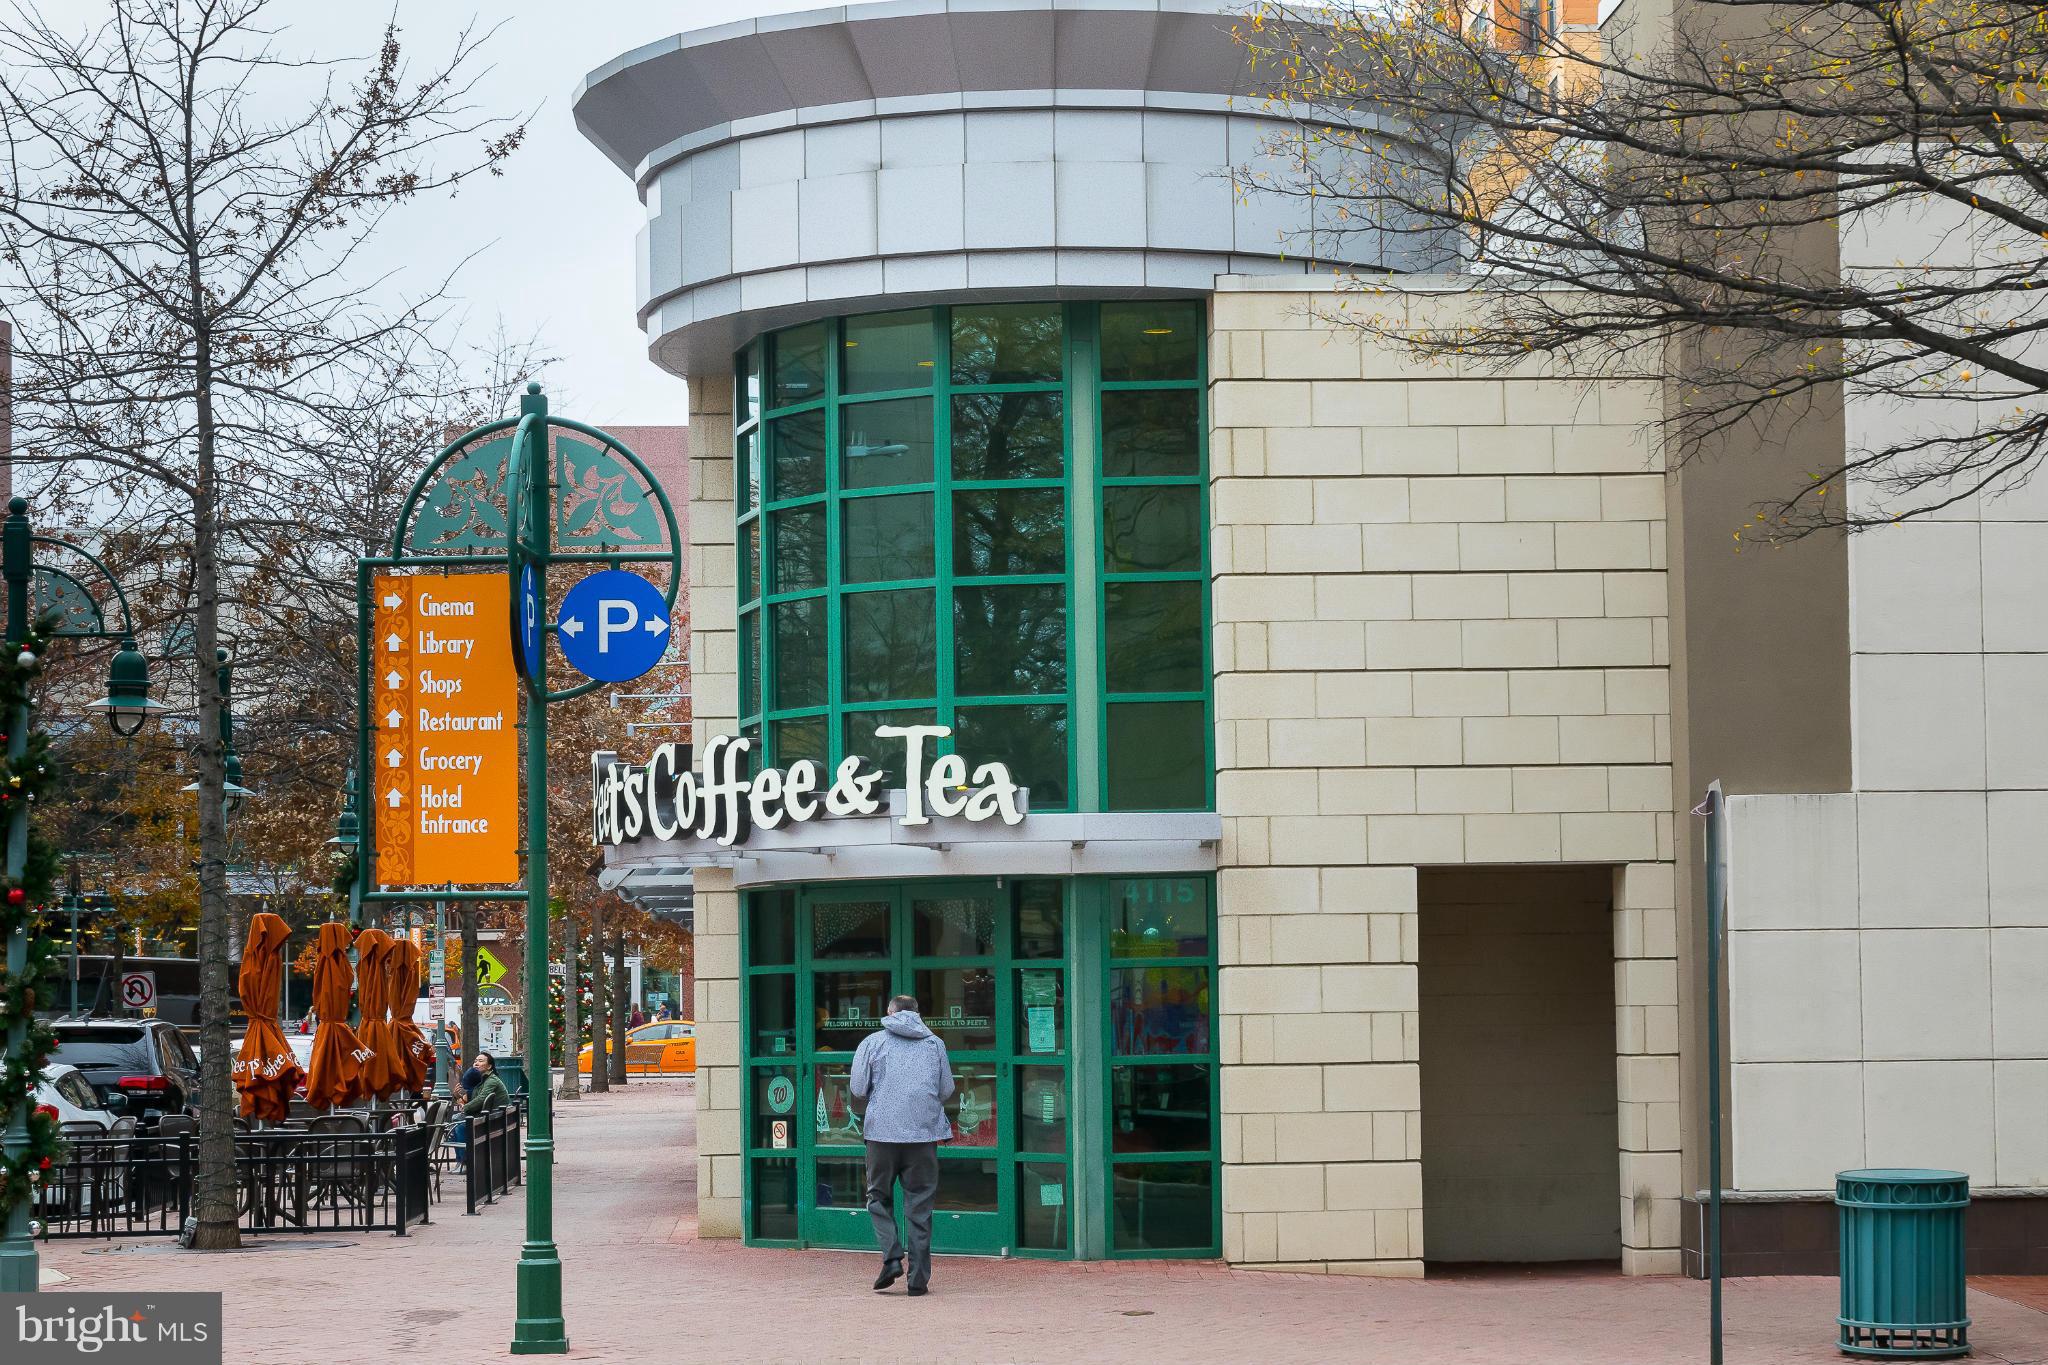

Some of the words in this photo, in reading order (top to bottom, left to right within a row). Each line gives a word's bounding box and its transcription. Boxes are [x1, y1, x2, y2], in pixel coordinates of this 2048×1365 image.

[419, 592, 474, 617] Cinema
[526, 593, 535, 648] P
[598, 599, 639, 654] P
[419, 631, 475, 659] Library
[419, 670, 462, 698] Shops
[419, 709, 503, 731] Restaurant
[420, 747, 483, 775] Grocery
[420, 785, 462, 808] Hotel
[591, 750, 644, 847] Peet's
[648, 734, 818, 847] Coffee
[825, 755, 883, 816] &
[874, 724, 1024, 827] Tea
[420, 811, 489, 834] Entrance
[1125, 880, 1195, 904] 4115
